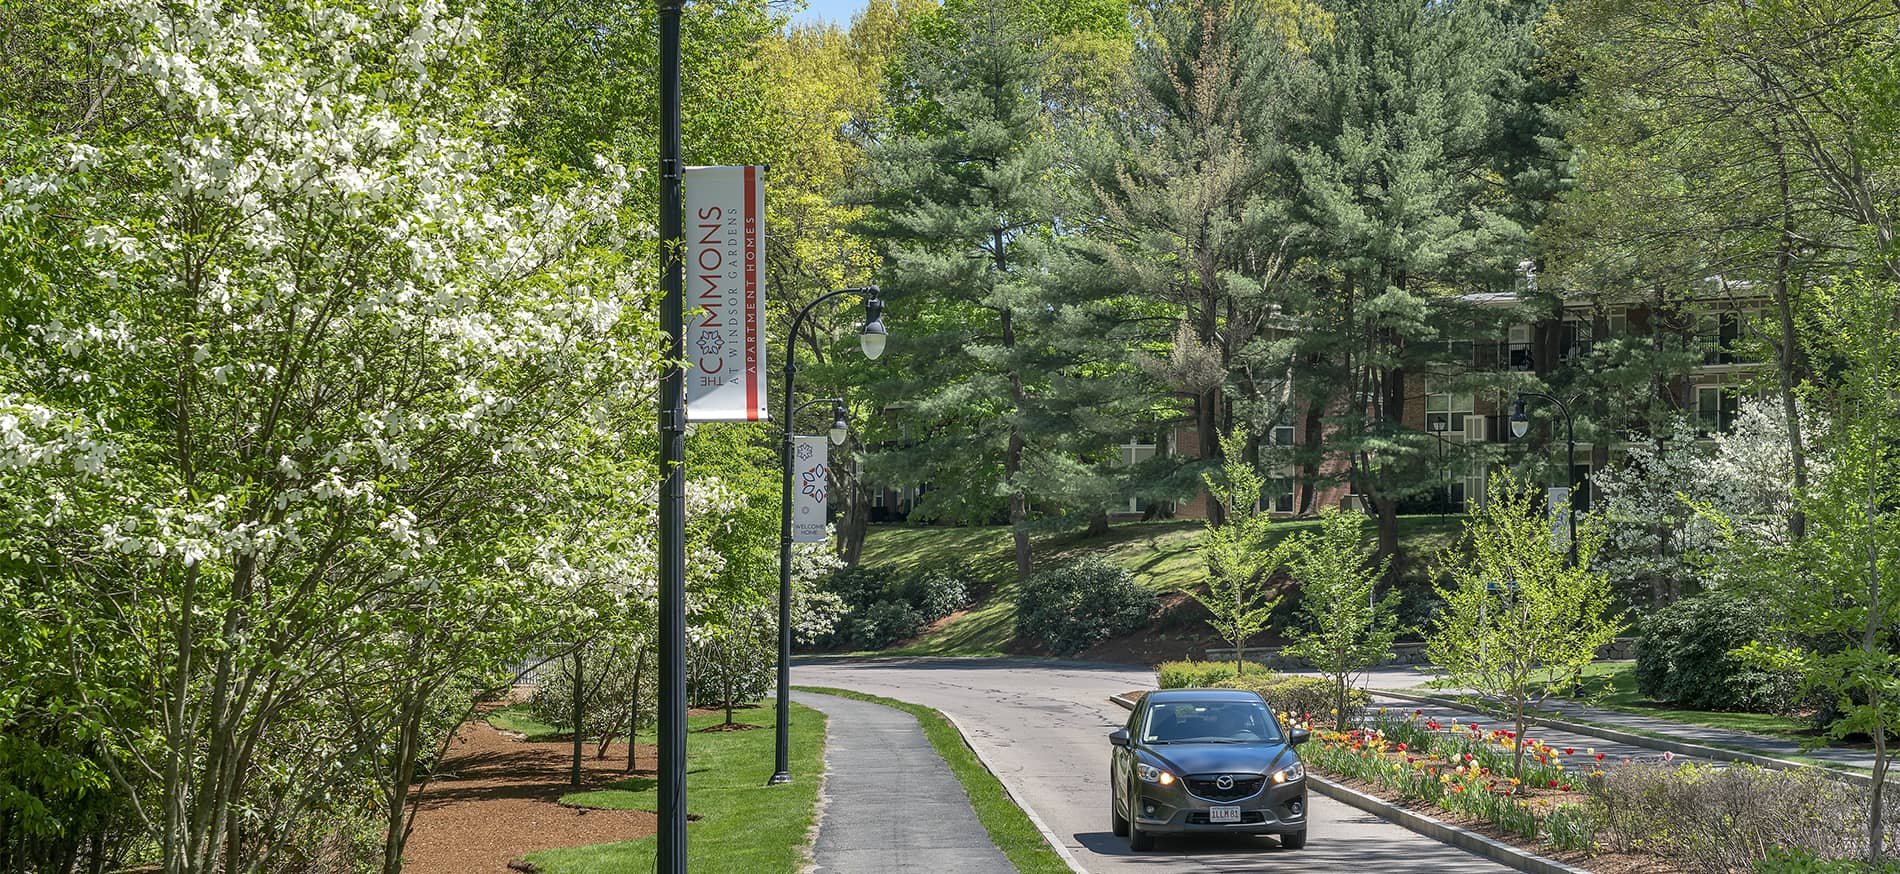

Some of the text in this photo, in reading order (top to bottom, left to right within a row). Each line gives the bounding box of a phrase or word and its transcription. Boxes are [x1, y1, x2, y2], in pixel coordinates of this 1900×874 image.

[727, 207, 739, 385] AT WINDSOR GARDENS
[745, 217, 756, 374] APARTMENT HOMES
[700, 376, 724, 387] THE
